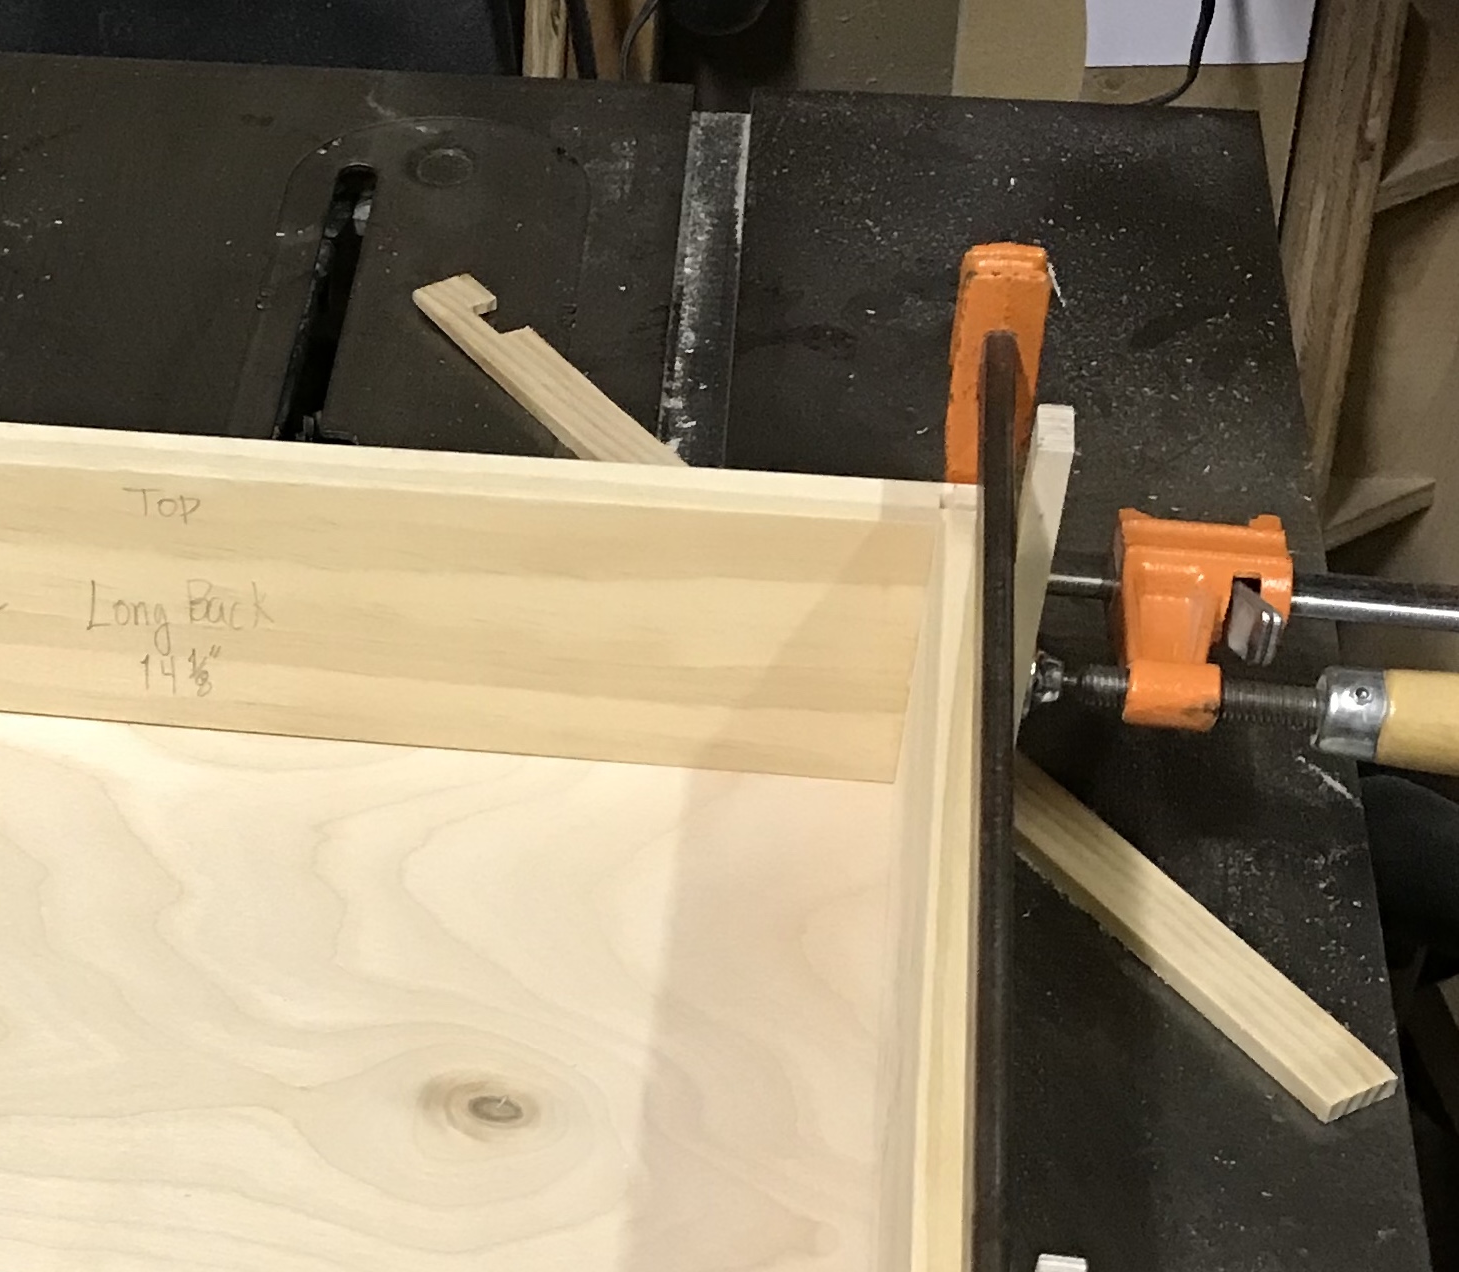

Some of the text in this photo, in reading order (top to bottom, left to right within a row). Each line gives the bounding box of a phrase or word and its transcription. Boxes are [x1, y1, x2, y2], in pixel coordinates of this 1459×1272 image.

[86, 578, 275, 656] Long Back
[140, 653, 177, 694] 14
